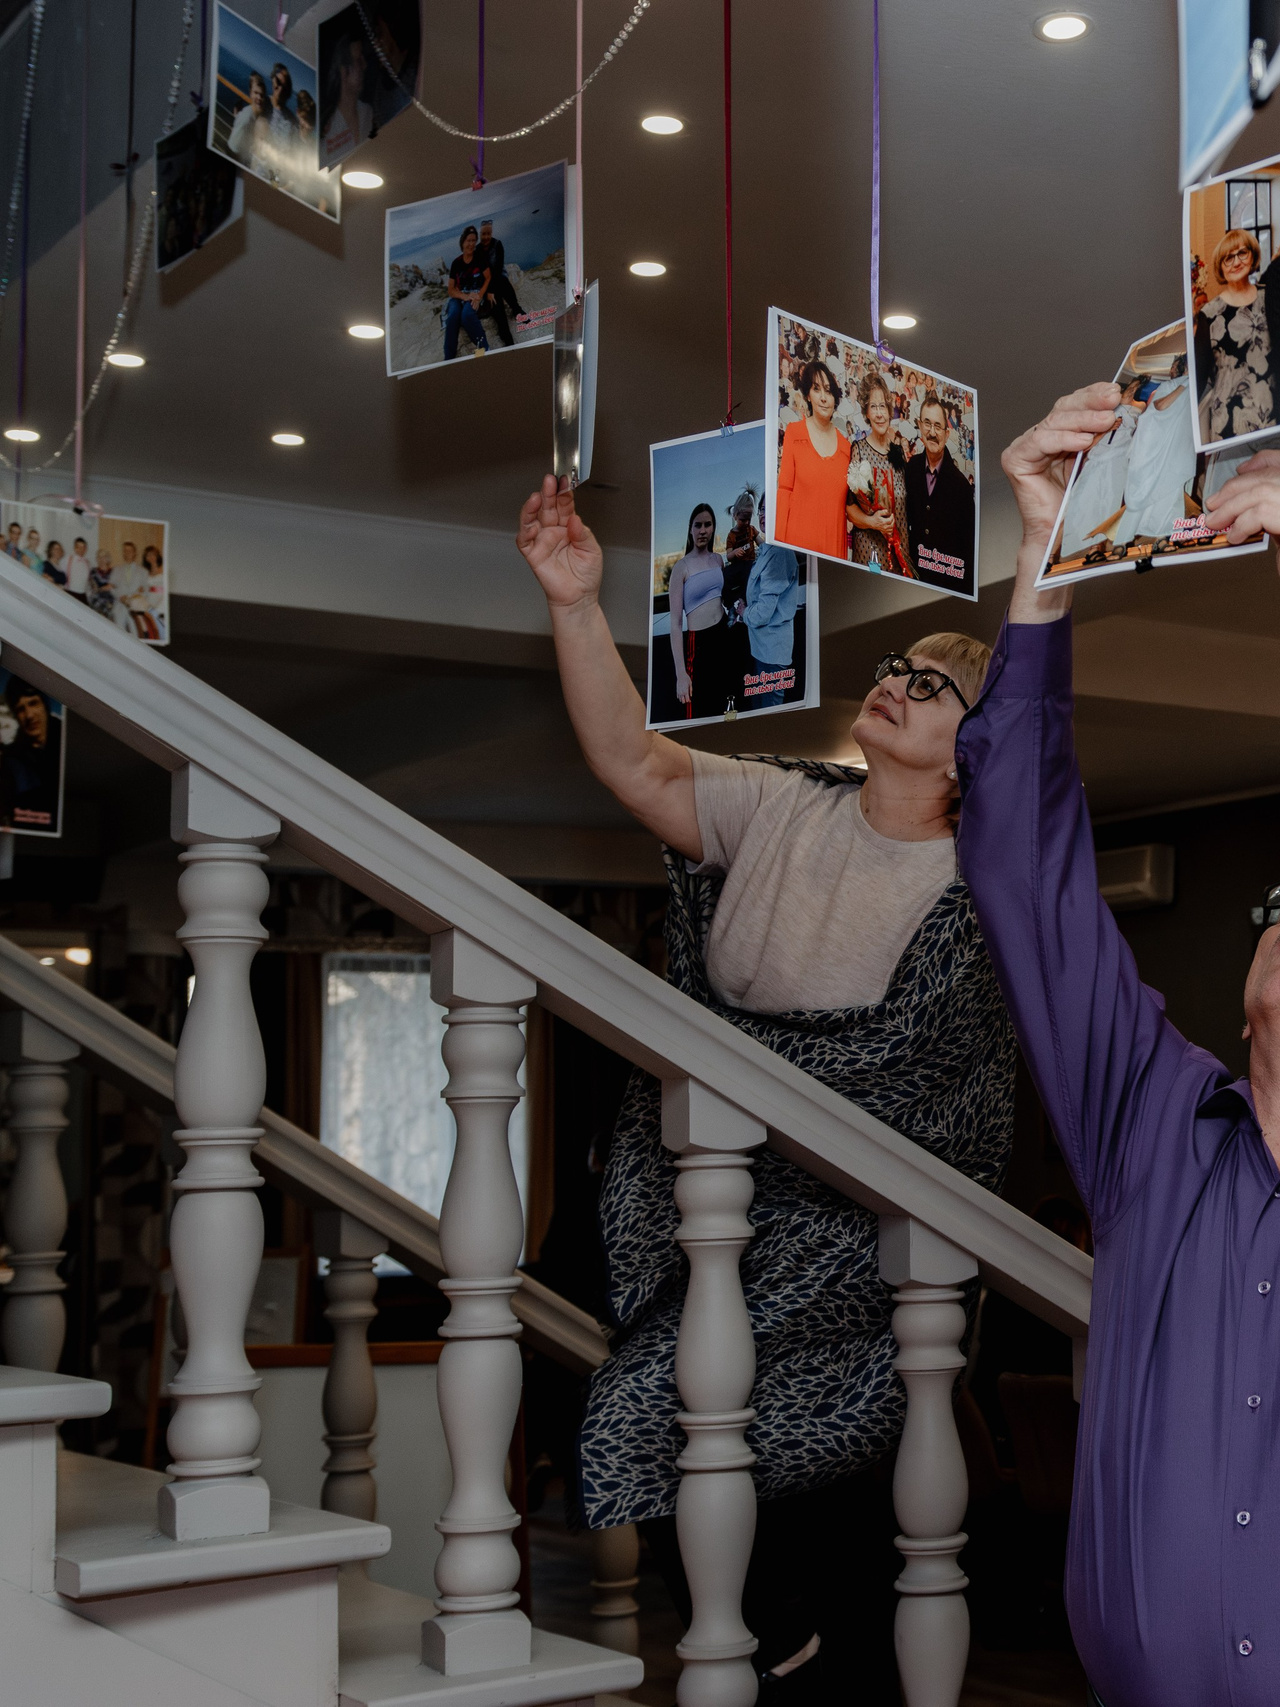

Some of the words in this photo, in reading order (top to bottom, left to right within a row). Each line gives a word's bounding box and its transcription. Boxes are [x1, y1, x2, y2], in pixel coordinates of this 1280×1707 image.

[1173, 516, 1195, 529] Вне
[918, 544, 931, 558] Вне
[744, 673, 759, 685] Вне
